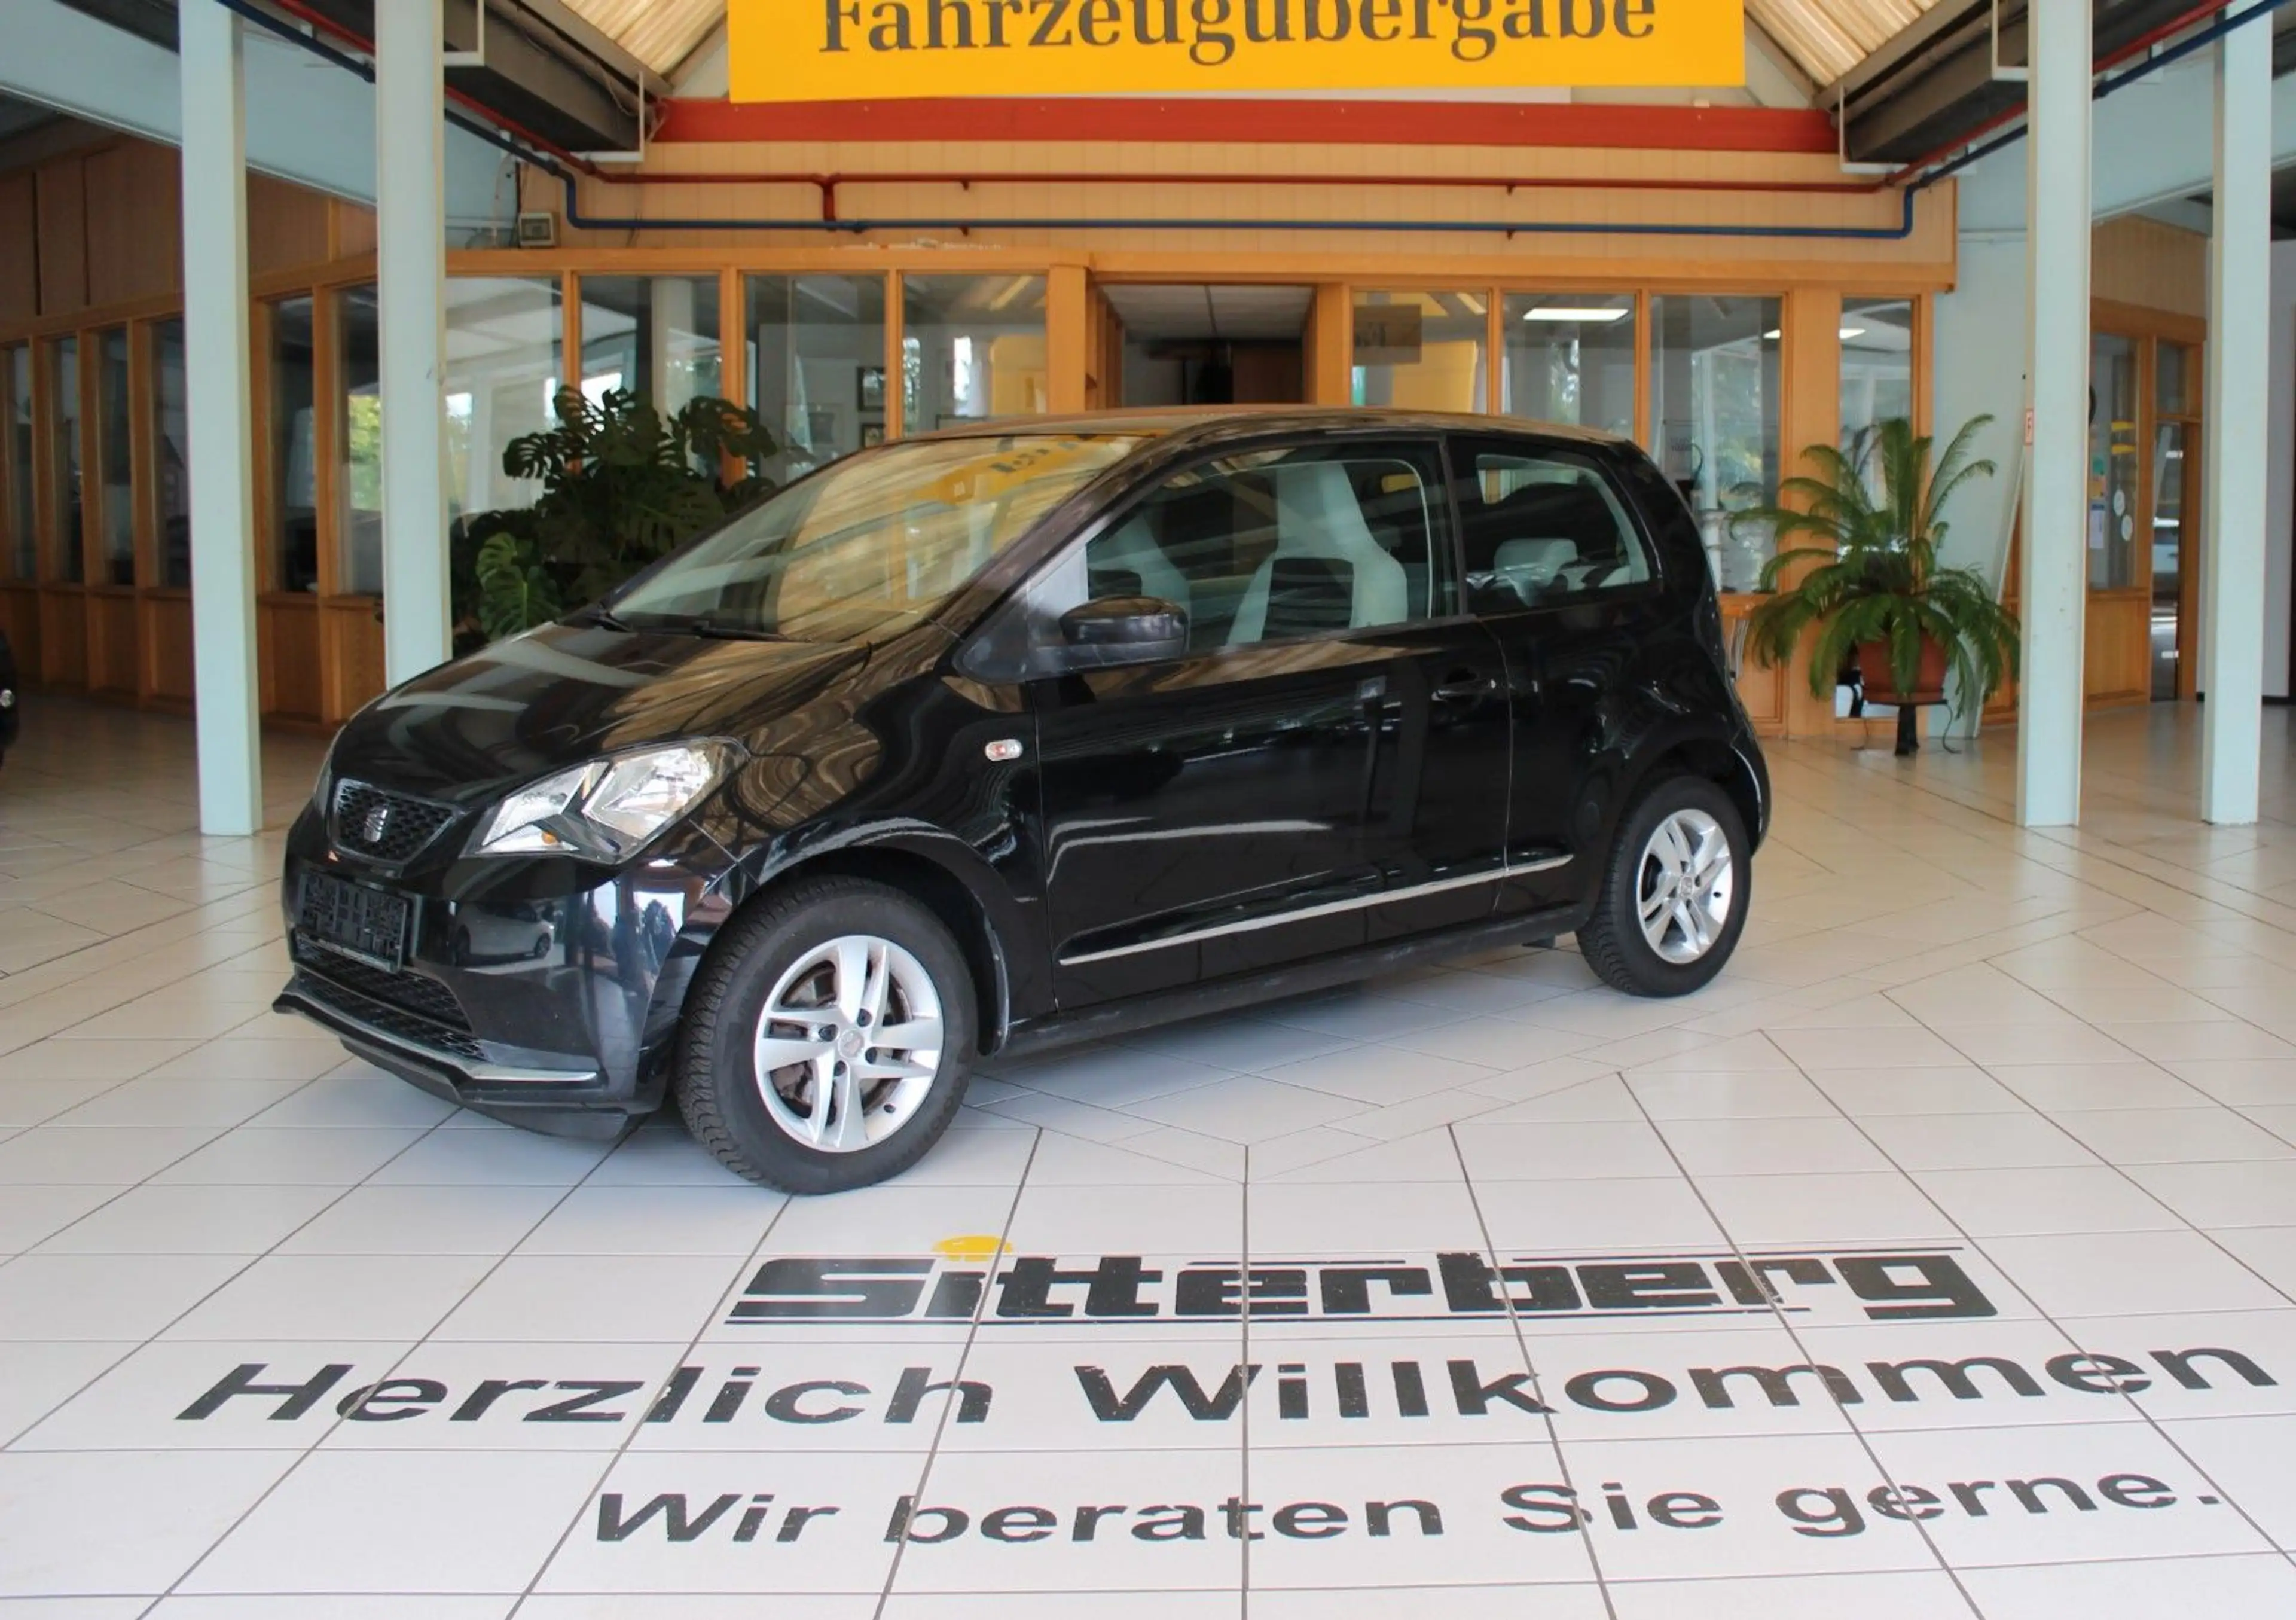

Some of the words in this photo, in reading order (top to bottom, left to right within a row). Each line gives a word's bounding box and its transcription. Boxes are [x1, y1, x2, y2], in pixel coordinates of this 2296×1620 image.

[730, 1235, 1998, 1320] Sitterberg
[176, 1364, 991, 1422] Herzlich
[1074, 1347, 2277, 1421] Willkommen
[596, 1494, 839, 1541] Wir
[883, 1495, 1445, 1543] beraten
[1502, 1483, 1722, 1530] Sie
[1776, 1474, 2219, 1537] gerne.
